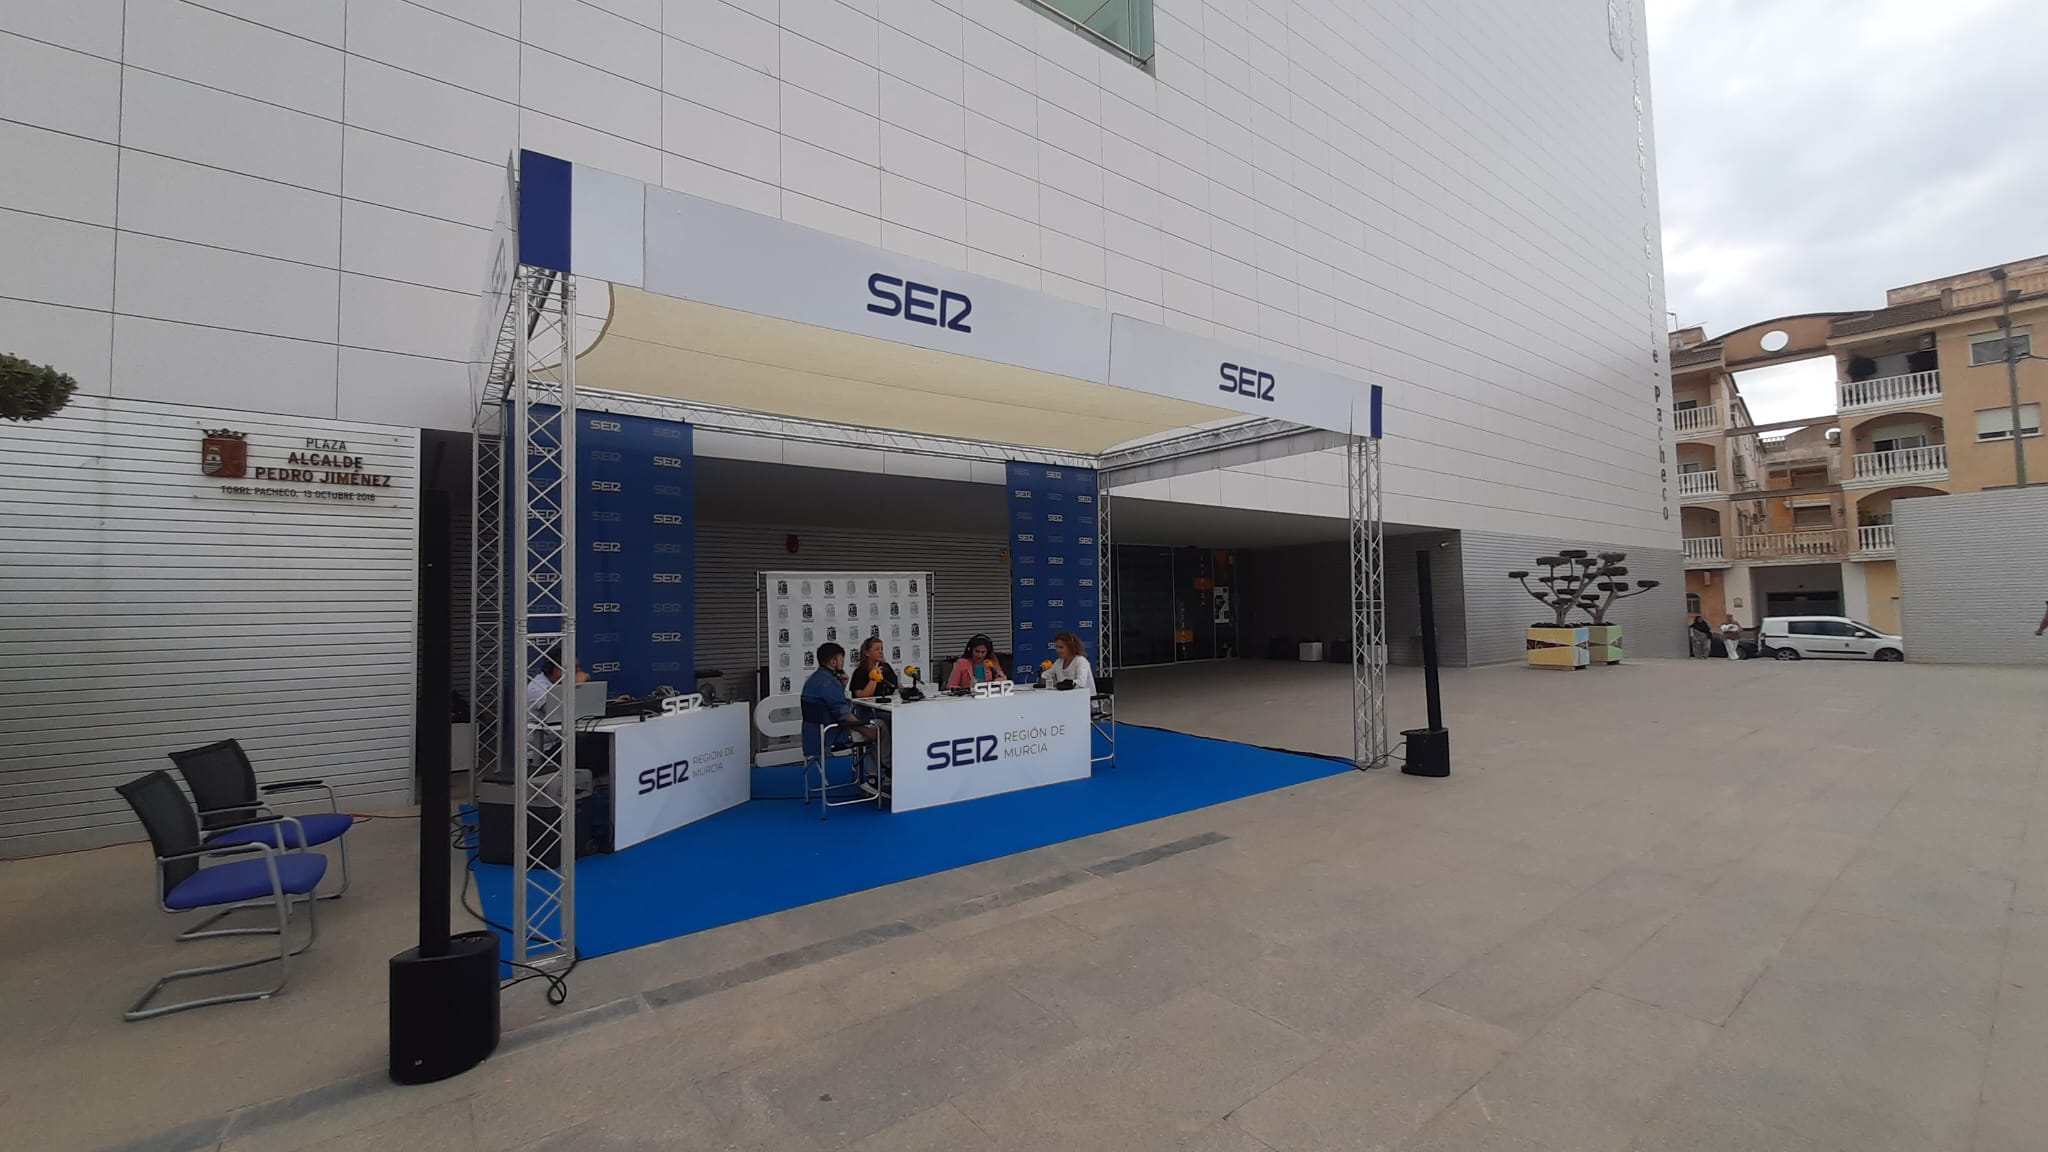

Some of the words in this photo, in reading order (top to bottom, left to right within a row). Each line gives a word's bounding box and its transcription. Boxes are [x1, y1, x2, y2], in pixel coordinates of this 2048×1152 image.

[866, 272, 972, 334] SER
[1218, 361, 1275, 403] SER
[590, 420, 622, 433] SER
[306, 437, 347, 452] PLAZA
[288, 451, 363, 469] ALCALDE
[653, 456, 682, 468] SER
[255, 466, 314, 483] PEDRO
[319, 469, 391, 488] JIMÉNEZ
[591, 481, 622, 492] SER
[653, 514, 683, 525] SER
[592, 541, 622, 552] SER
[652, 573, 683, 583] SER
[593, 602, 621, 613] SER
[651, 632, 681, 643] SER
[592, 662, 621, 673] SER
[973, 680, 1015, 699] SER
[661, 693, 703, 717] SER
[926, 734, 998, 771] SER
[1004, 725, 1047, 742] REGIÓN
[1050, 725, 1065, 736] DE
[1004, 743, 1048, 759] MURCIA
[638, 759, 689, 795] SER
